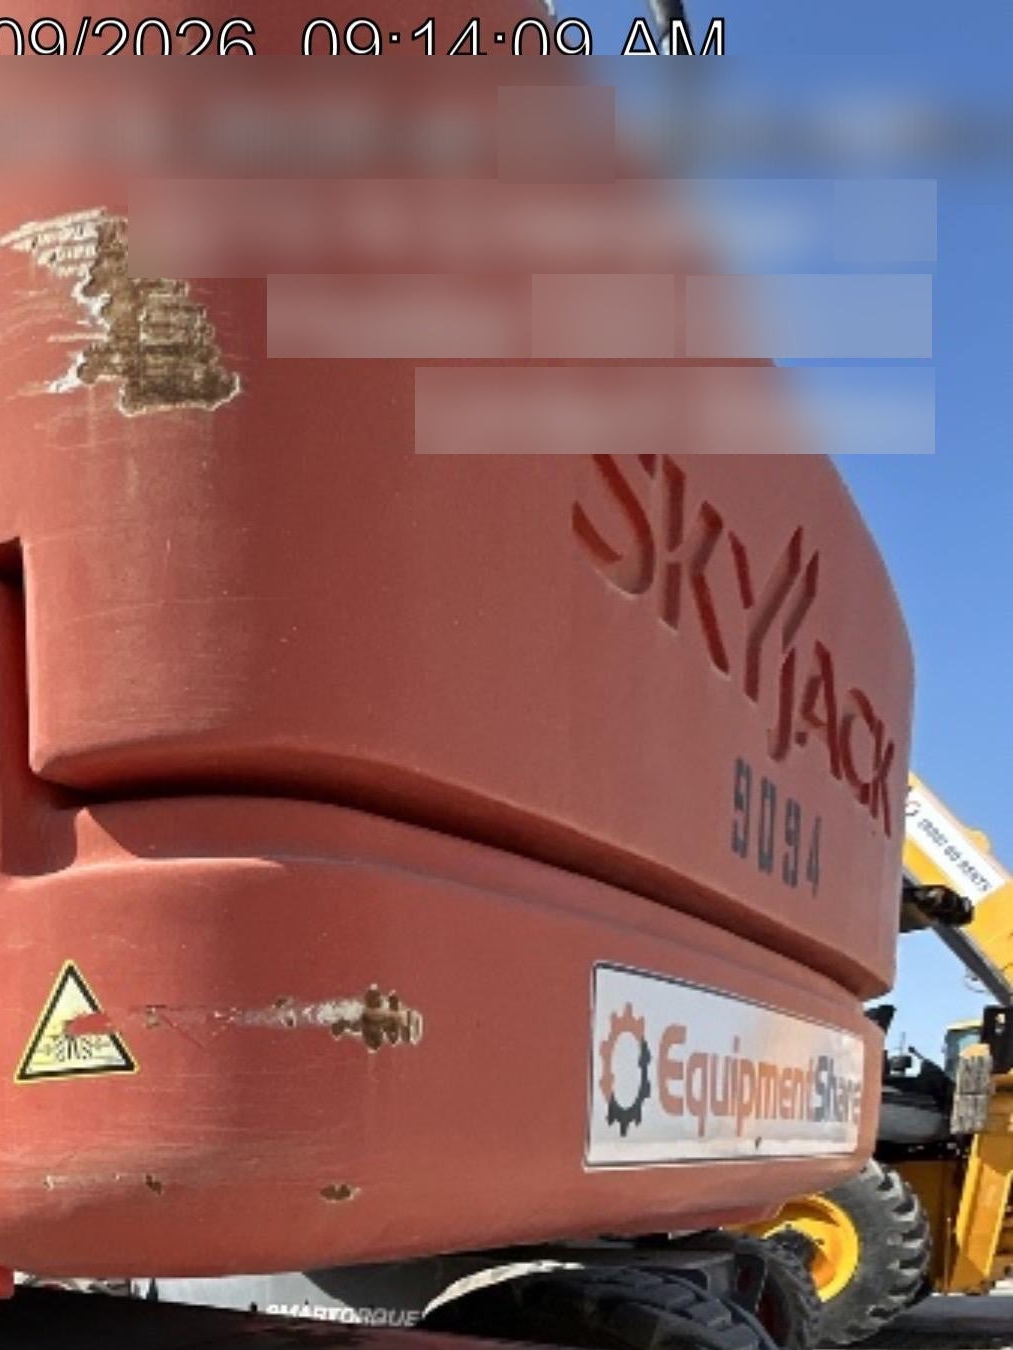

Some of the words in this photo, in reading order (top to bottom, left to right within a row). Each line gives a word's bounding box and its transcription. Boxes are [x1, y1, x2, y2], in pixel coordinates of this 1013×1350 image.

[571, 453, 895, 838] SKYJACK
[730, 757, 823, 899] 9094
[657, 1022, 862, 1138] EquipmentShare
